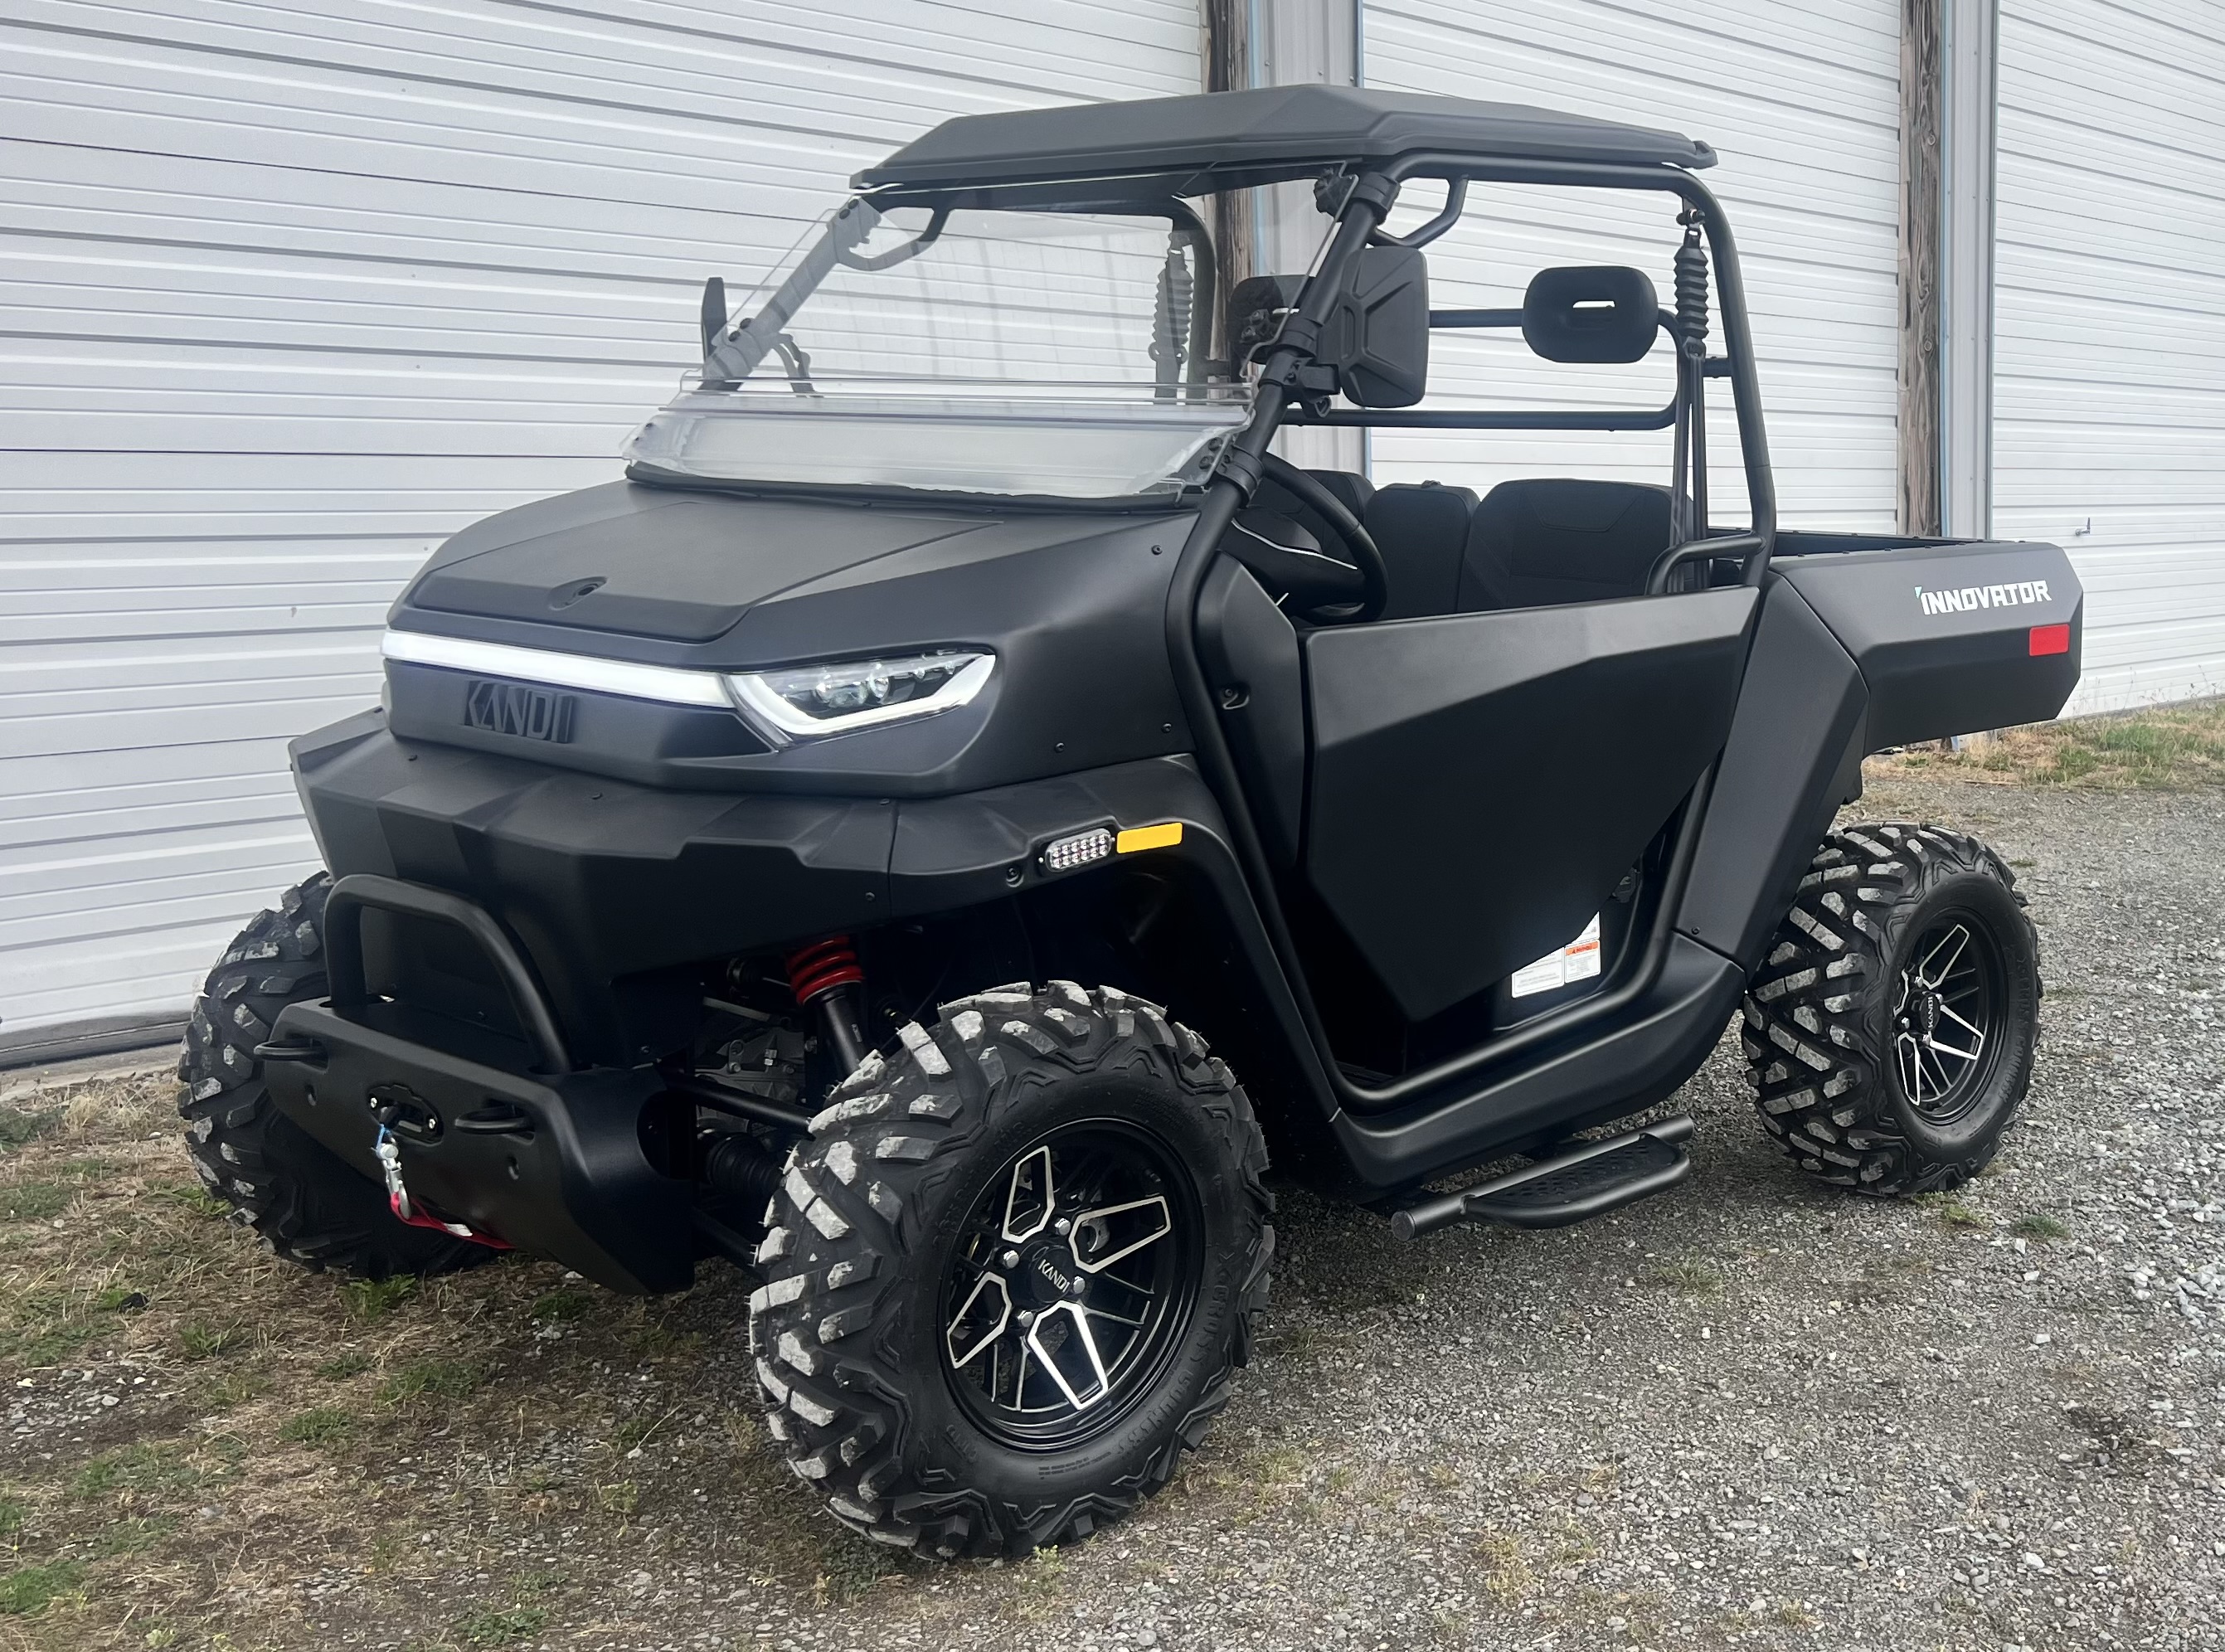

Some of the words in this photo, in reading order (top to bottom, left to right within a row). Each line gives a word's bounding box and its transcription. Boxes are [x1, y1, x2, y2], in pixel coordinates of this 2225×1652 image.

[1914, 580, 2052, 615] INNOVATOR
[464, 680, 572, 744] KANDI
[1038, 1259, 1070, 1293] KANDI
